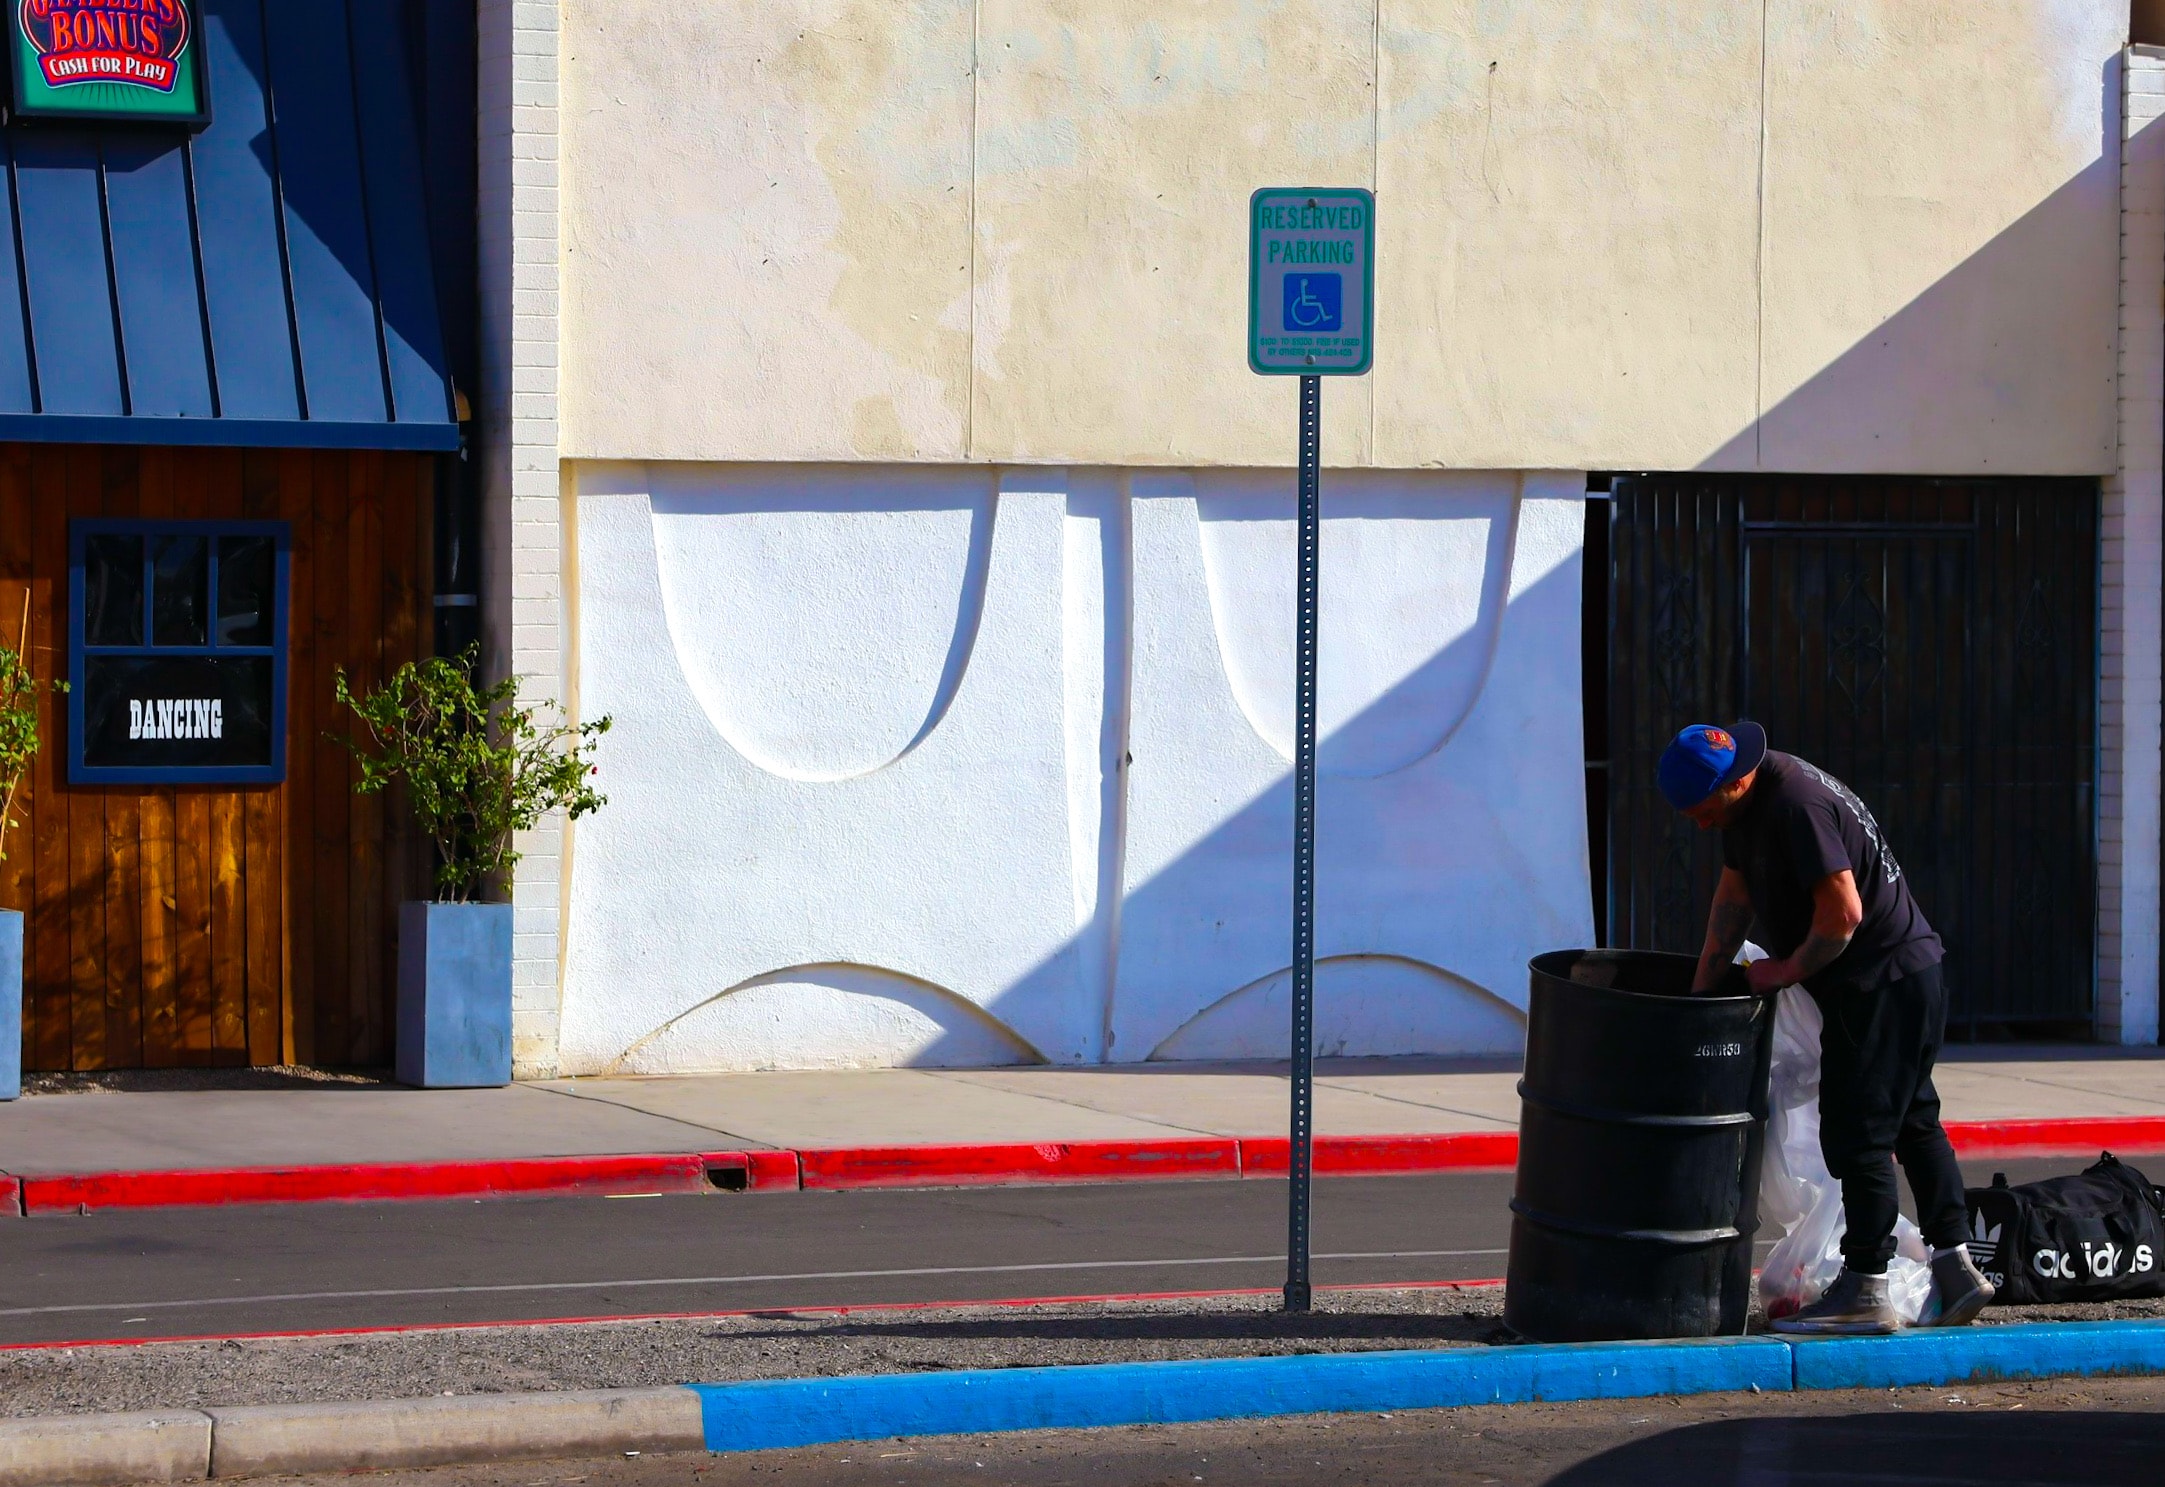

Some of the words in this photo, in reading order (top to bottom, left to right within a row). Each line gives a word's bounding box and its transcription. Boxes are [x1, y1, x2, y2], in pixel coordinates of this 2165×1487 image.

[51, 9, 161, 54] BONUS
[50, 57, 87, 77] CASH
[91, 57, 121, 74] FOR
[125, 57, 167, 81] PLAY
[1261, 206, 1362, 230] RESERVED
[1269, 240, 1354, 264] PARKING
[129, 698, 223, 740] DANCING
[2033, 1242, 2154, 1279] aids
